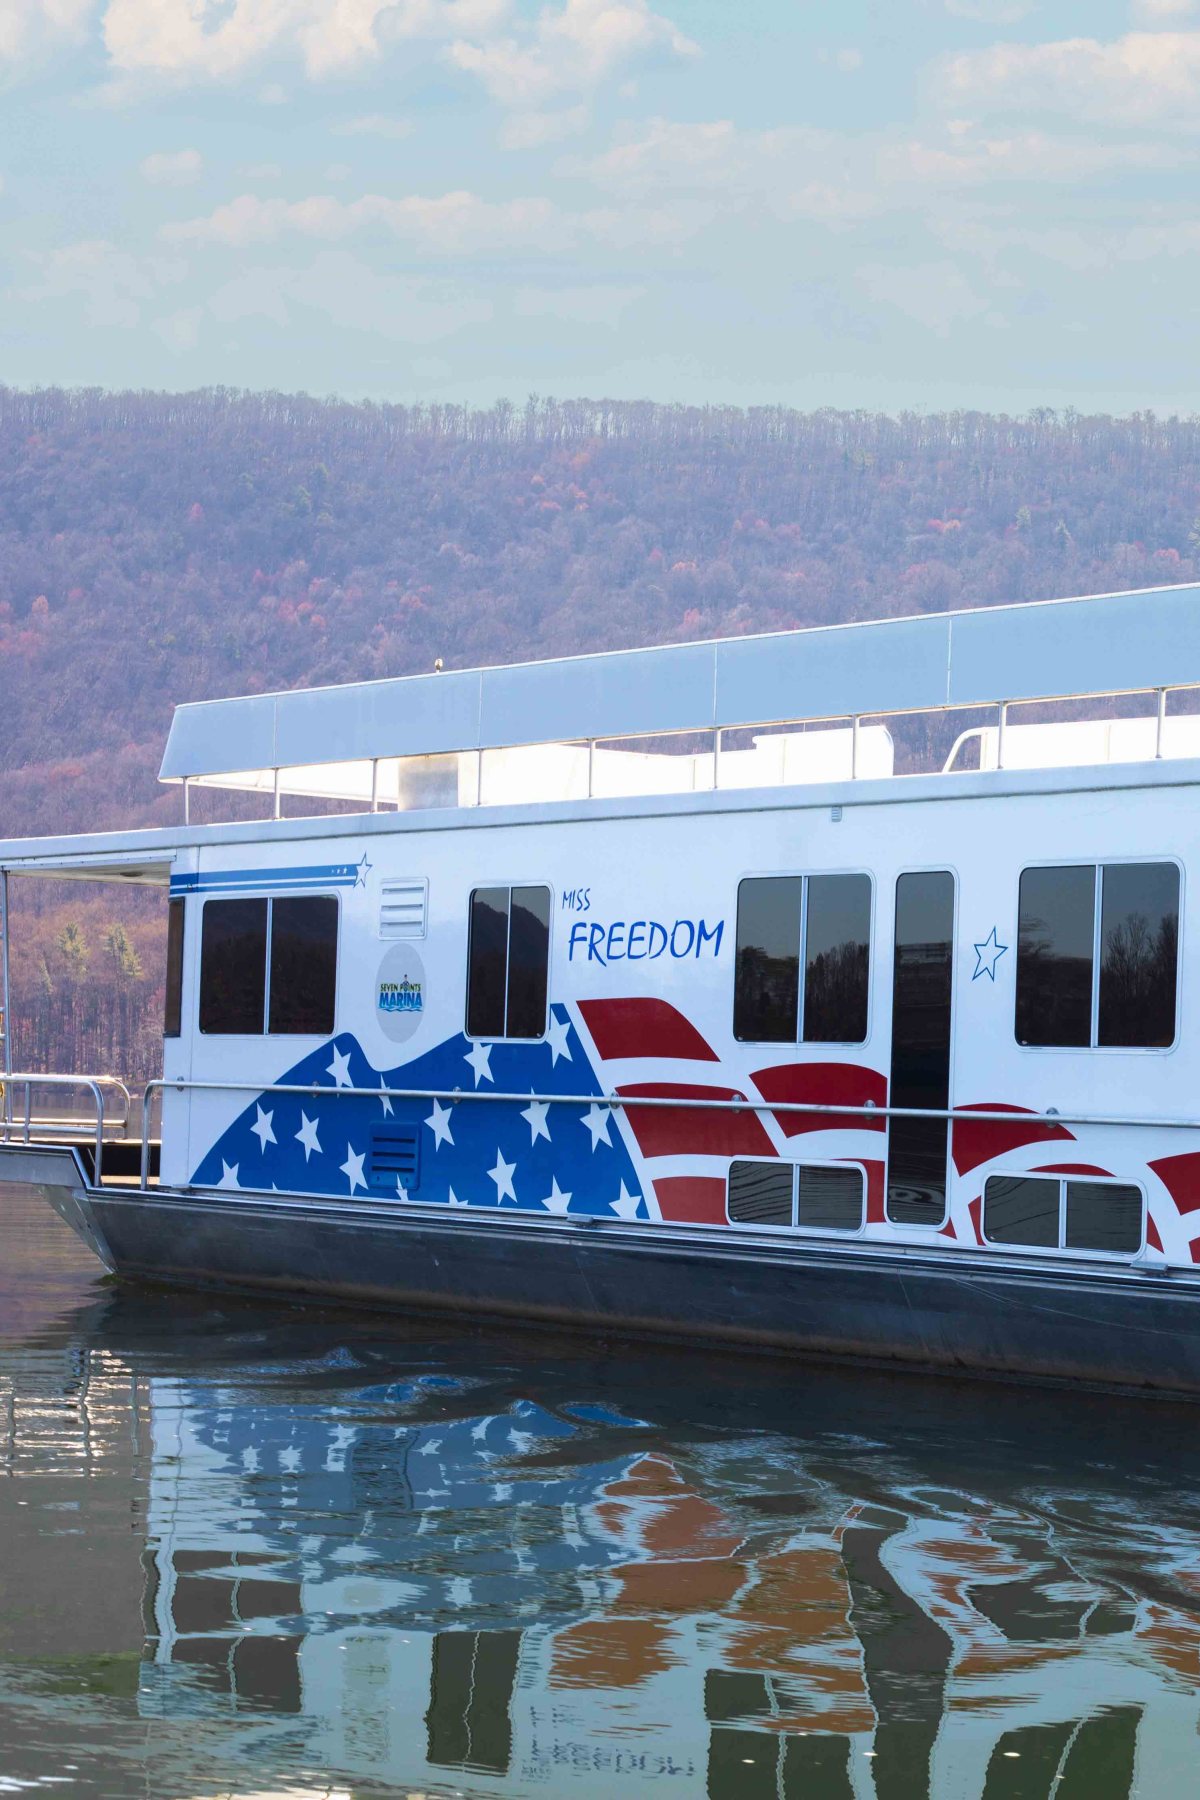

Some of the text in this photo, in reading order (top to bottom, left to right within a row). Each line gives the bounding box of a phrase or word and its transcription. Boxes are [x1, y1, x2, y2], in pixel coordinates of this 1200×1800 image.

[562, 888, 591, 911] MISS
[568, 919, 725, 967] FREEDOM
[380, 983, 398, 991] SEVEN
[379, 992, 423, 1007] MARINA
